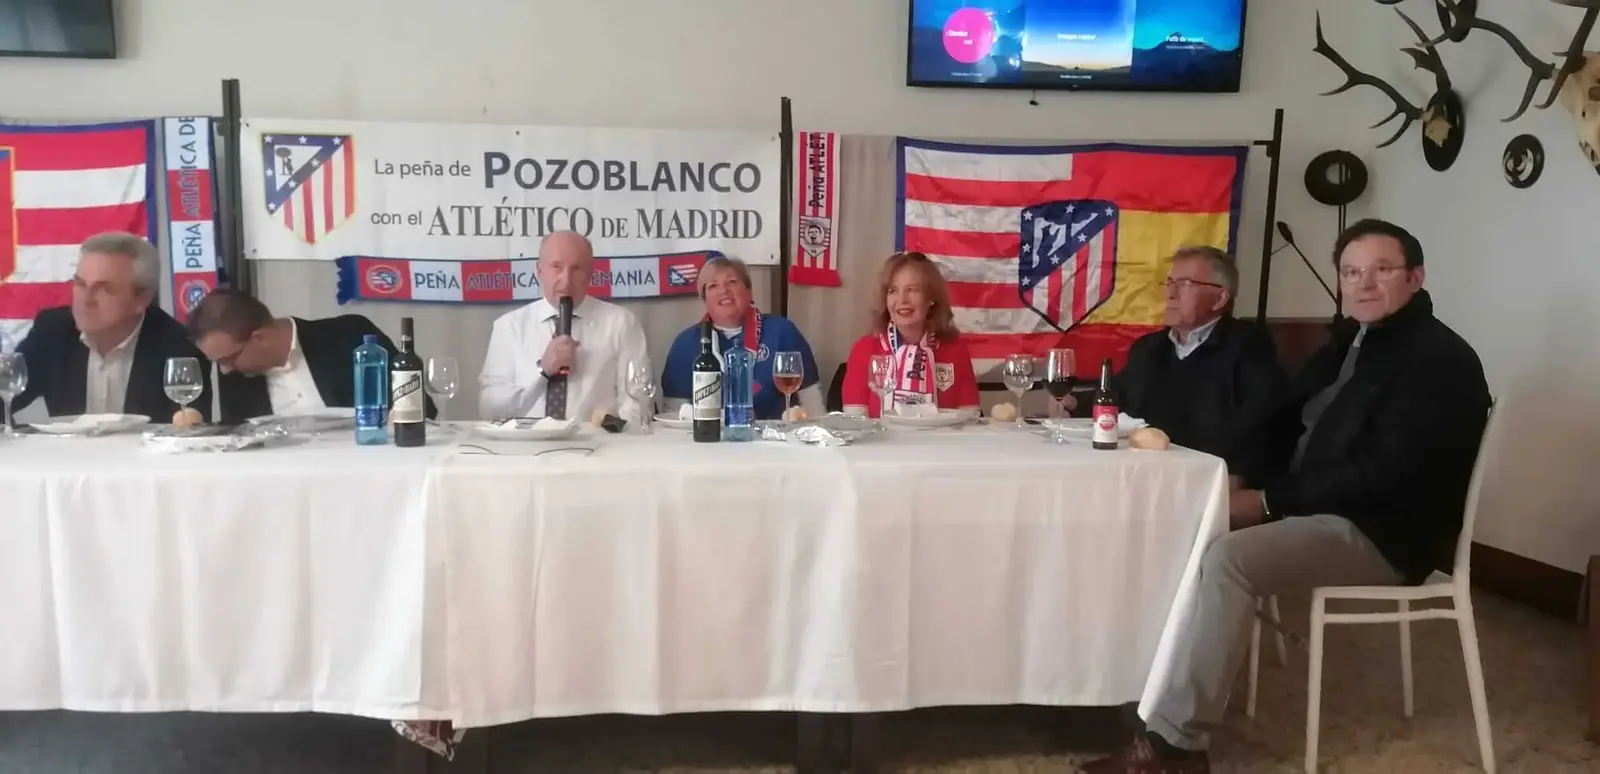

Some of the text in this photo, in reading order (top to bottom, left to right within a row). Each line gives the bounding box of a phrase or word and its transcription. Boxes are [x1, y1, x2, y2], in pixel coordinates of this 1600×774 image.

[374, 152, 761, 193] La peña de POZOBLANCO
[808, 177, 825, 208] Peña
[371, 196, 763, 239] con el ATLÉTICO DE MADRID
[181, 223, 203, 269] PEÑA
[414, 270, 460, 289] PEÑA
[589, 268, 656, 287] EMANIA
